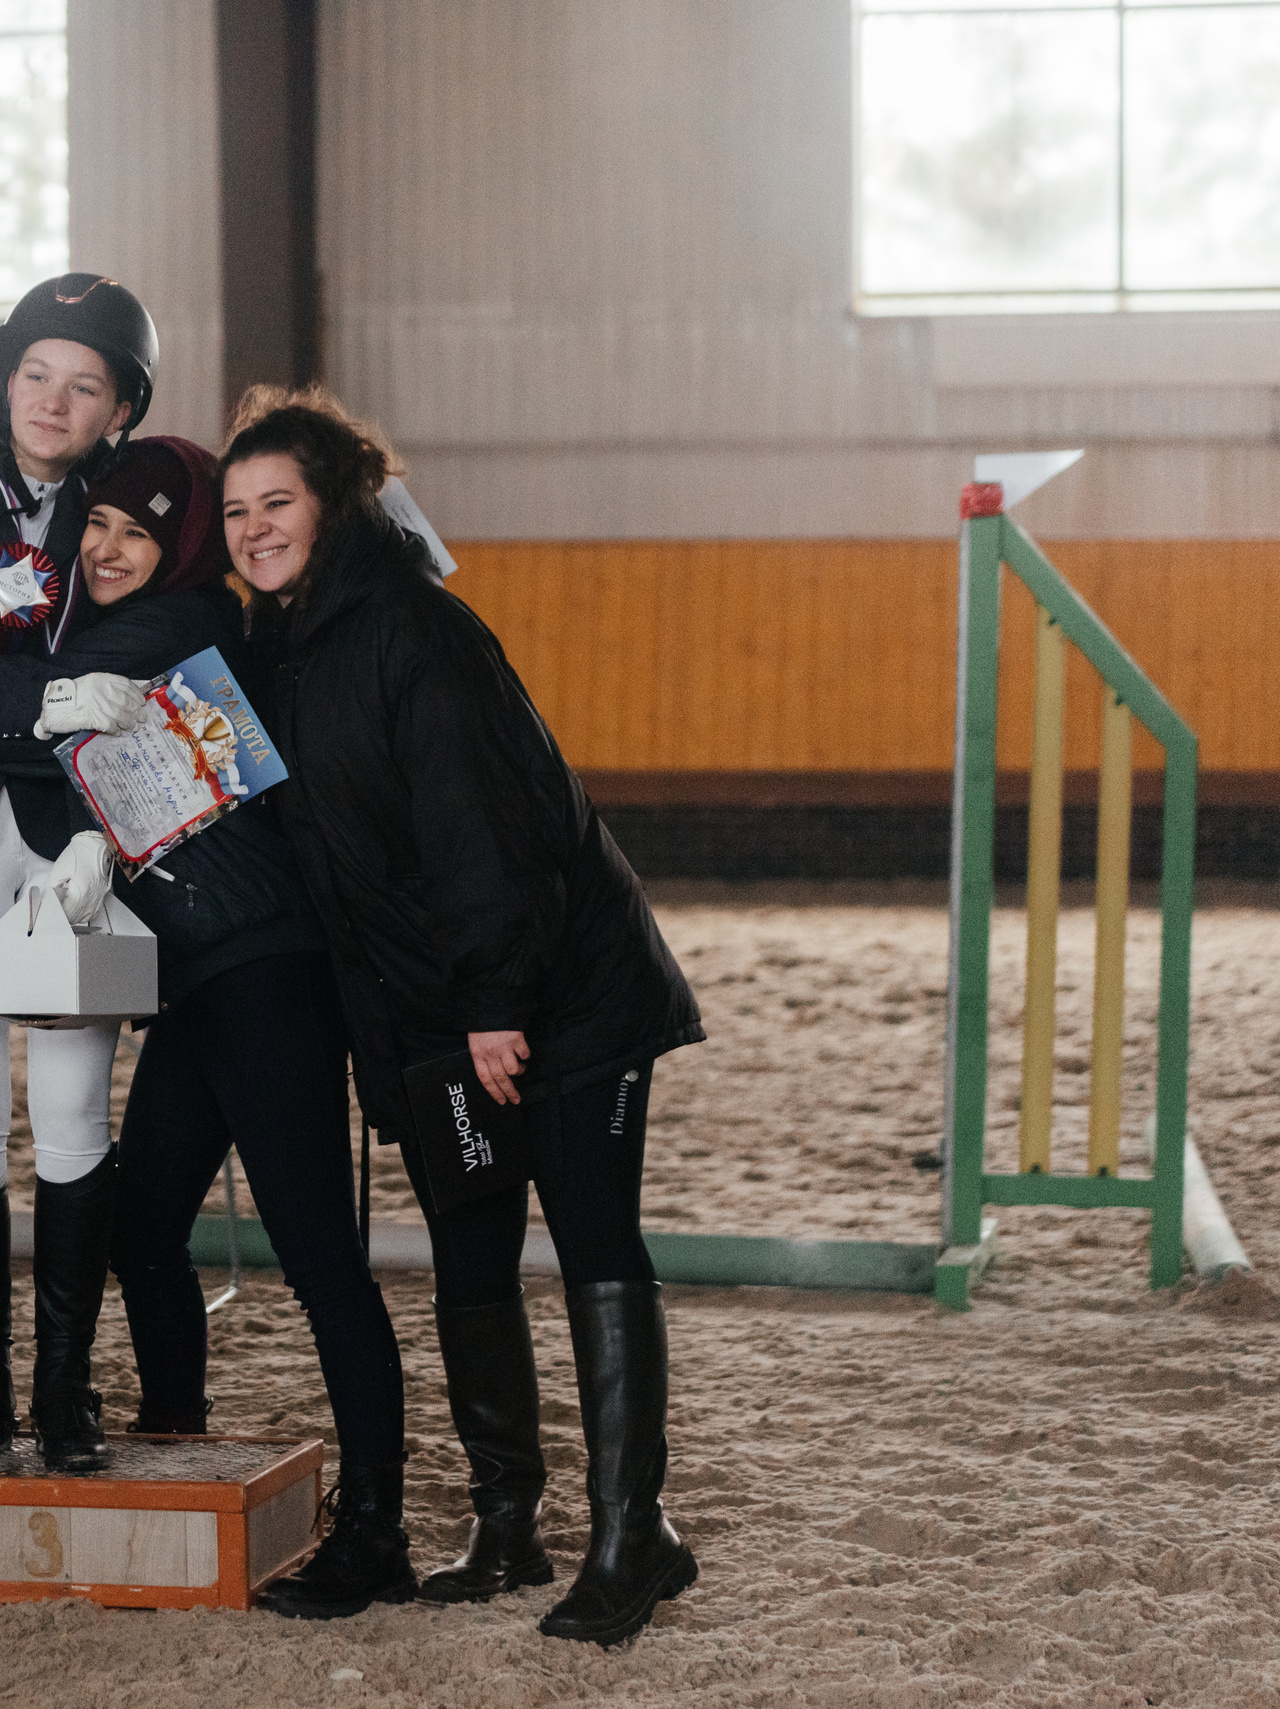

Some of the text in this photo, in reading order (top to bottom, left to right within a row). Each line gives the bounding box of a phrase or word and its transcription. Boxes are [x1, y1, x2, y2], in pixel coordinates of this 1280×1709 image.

[0, 580, 31, 600] ИСТОРИЯ
[47, 695, 72, 704] Roeckl
[210, 675, 270, 765] ГРАМОТА
[142, 725, 188, 800] НАГРАЖДАЕТСЯ
[448, 1083, 478, 1172] VILHORSE
[609, 1077, 629, 1134] Diamo
[485, 1139, 493, 1165] Moscow
[25, 1511, 64, 1578] 3
